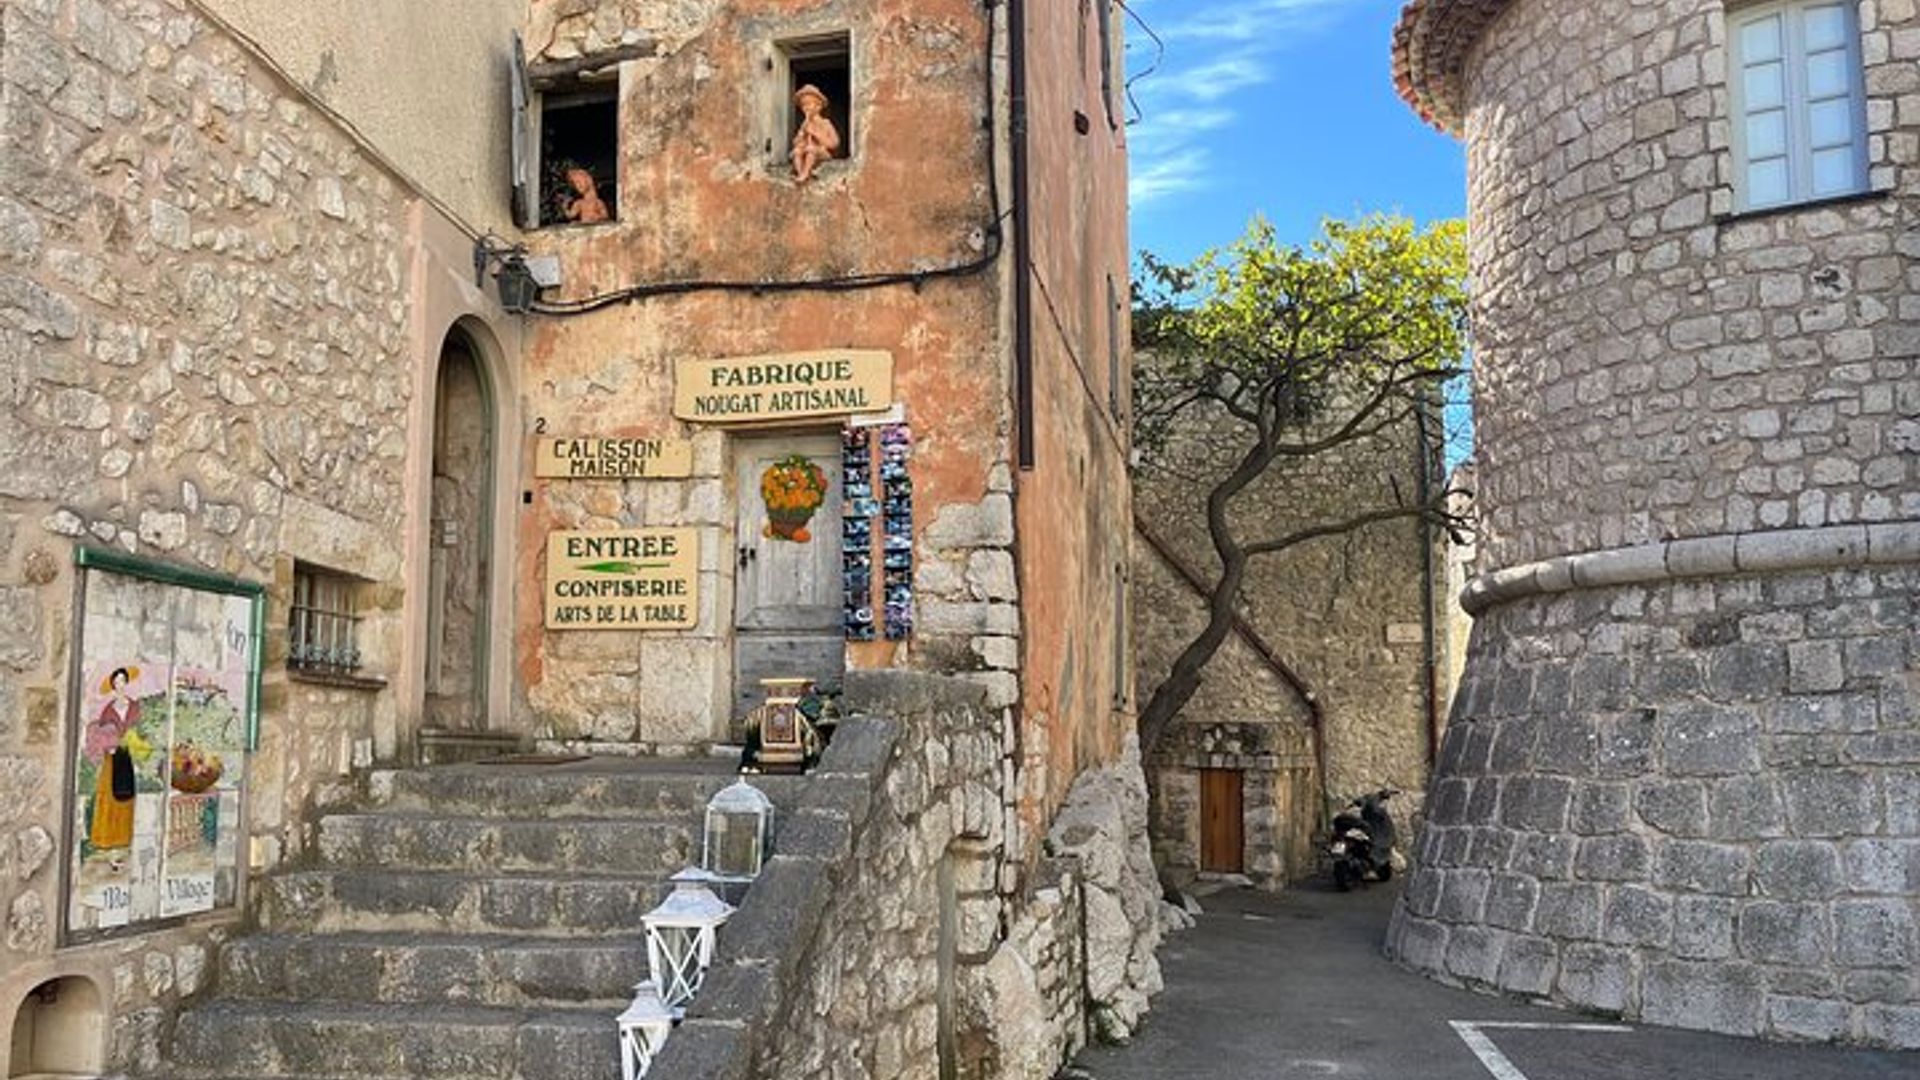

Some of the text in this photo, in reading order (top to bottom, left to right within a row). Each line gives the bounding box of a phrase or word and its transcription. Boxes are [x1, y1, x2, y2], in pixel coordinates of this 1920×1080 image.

[711, 360, 852, 387] FABRIQUE
[694, 387, 870, 416] NOUGAT ARTISANAL
[535, 417, 547, 435] 2
[553, 438, 662, 459] CALISSON
[570, 459, 646, 476] MAISON
[567, 536, 679, 558] ENTREE
[554, 604, 688, 623] ARTS DE LA TABLE
